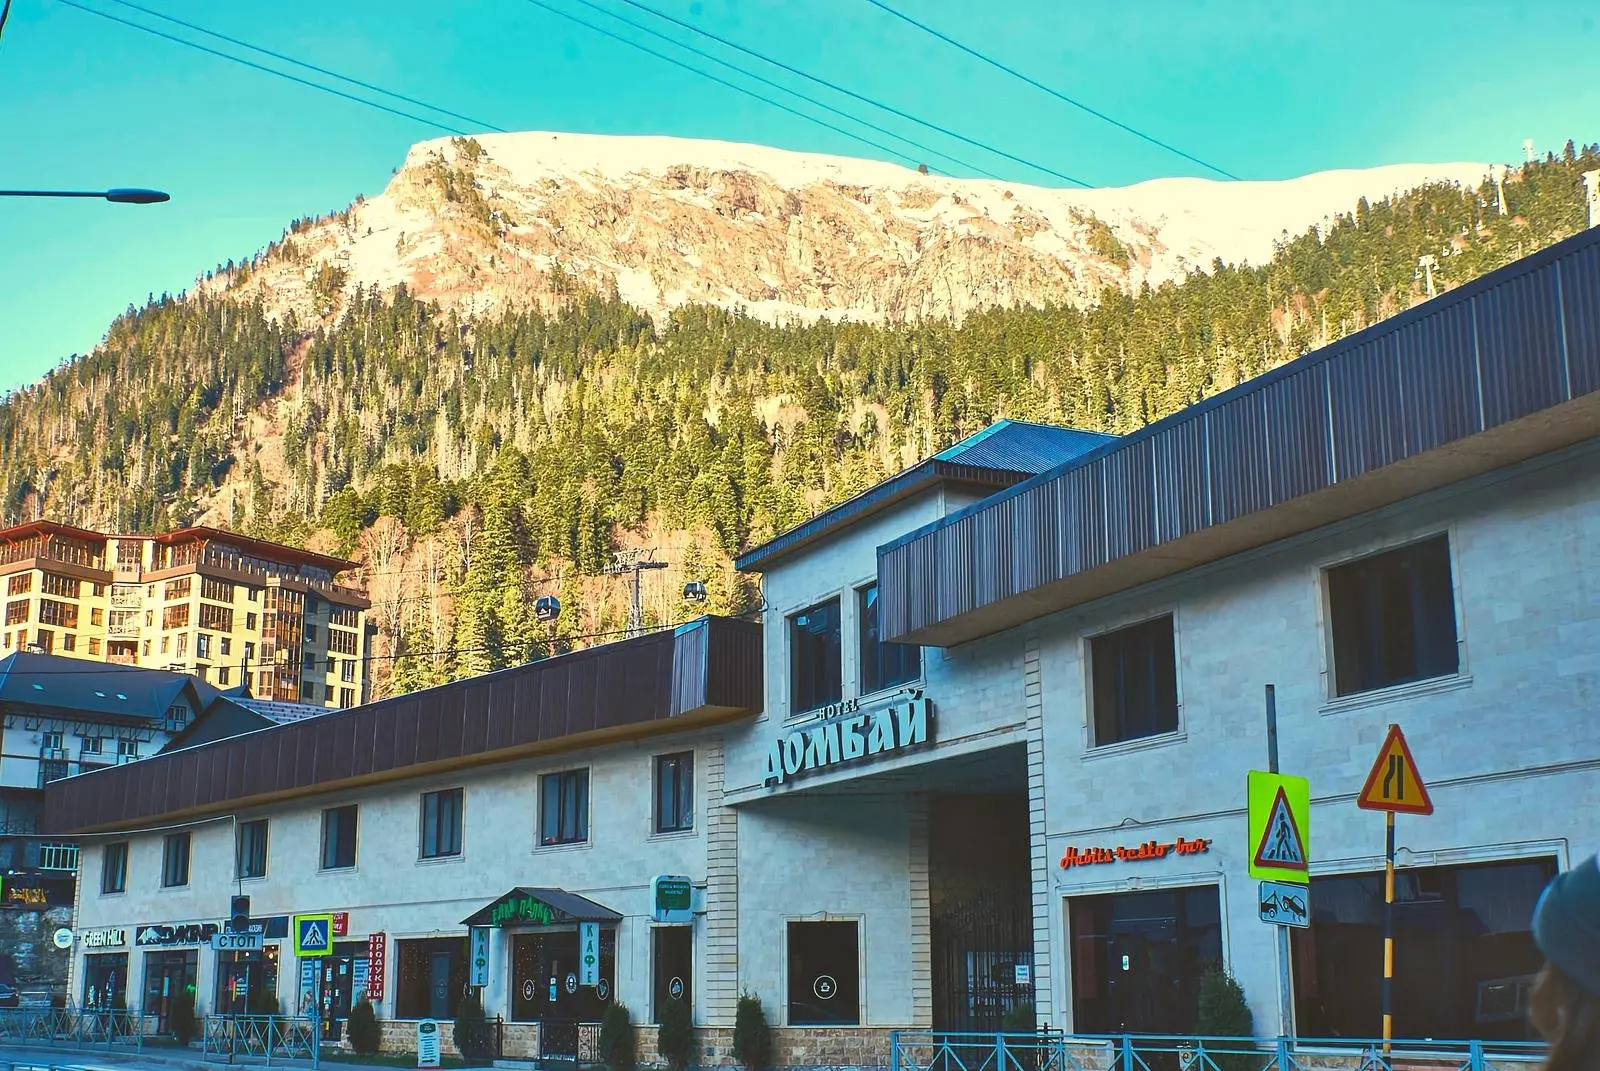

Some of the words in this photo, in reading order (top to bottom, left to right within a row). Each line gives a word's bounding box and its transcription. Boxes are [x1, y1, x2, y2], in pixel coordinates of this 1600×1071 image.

[760, 688, 929, 788] ДОМБАЙ
[817, 699, 860, 721] HOTEL
[84, 931, 107, 947] GREEN
[218, 935, 256, 948] СТОП
[374, 935, 383, 997] ПРОДУКТЫ
[475, 928, 486, 984] КАФЕ
[584, 925, 596, 984] КАФЕ
